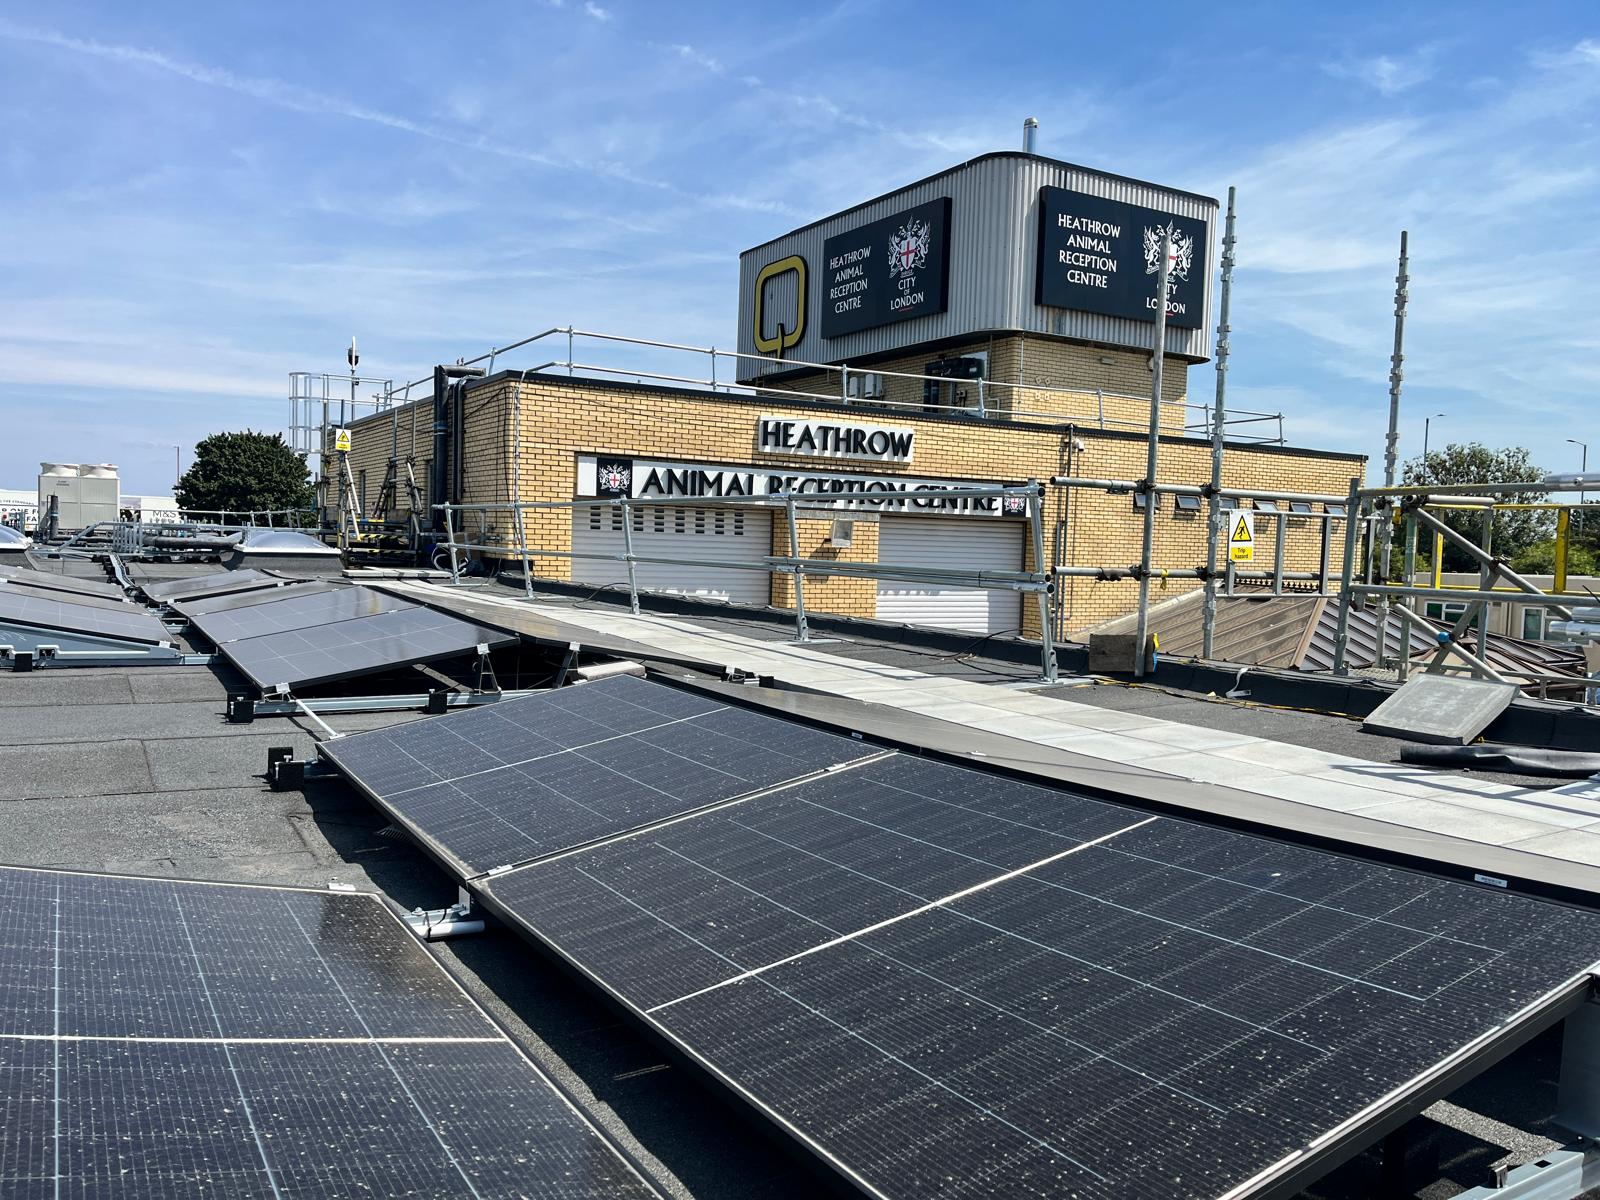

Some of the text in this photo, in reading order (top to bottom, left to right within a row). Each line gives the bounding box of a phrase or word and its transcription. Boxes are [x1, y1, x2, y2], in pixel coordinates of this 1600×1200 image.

[1058, 213, 1121, 238] HEATHROW
[1066, 234, 1111, 254] ANIMAL
[829, 245, 871, 270] HEATHROW
[1059, 250, 1117, 273] RECEPTION
[834, 264, 864, 283] ANIMAL
[898, 276, 916, 290] CITY
[1067, 269, 1108, 288] CENTRE
[830, 278, 868, 299] RECEPTION
[903, 288, 910, 296] OF
[834, 295, 862, 314] CENTRE
[890, 291, 924, 310] LONDON
[1146, 297, 1186, 314] LODON
[761, 420, 913, 457] HEATHROW
[641, 467, 757, 497] ANIMAL
[153, 510, 176, 518] M&S
